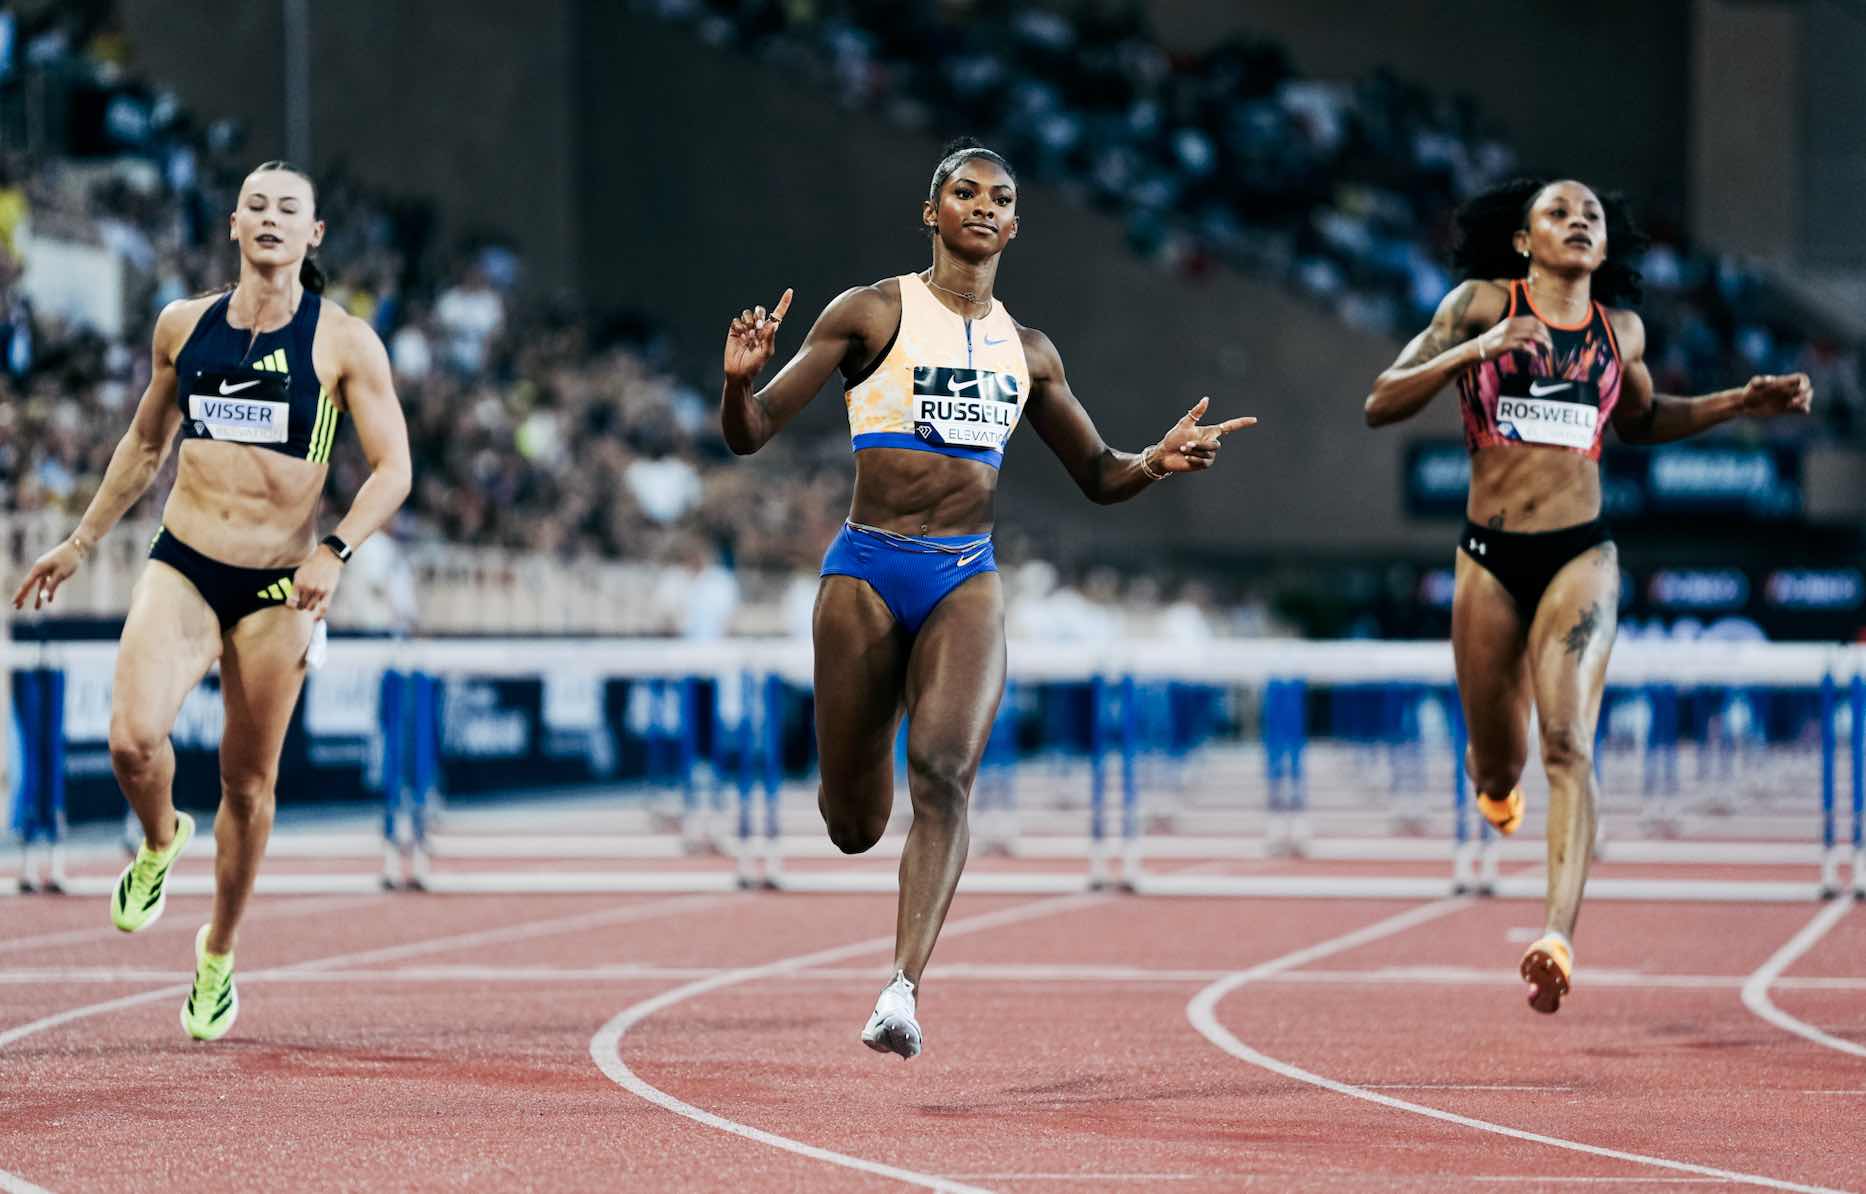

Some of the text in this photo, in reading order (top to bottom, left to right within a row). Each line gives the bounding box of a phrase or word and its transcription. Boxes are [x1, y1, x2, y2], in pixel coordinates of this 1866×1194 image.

[204, 402, 272, 423] VISSER
[920, 400, 1010, 427] RUSSELL
[1500, 402, 1593, 428] ROSWELL
